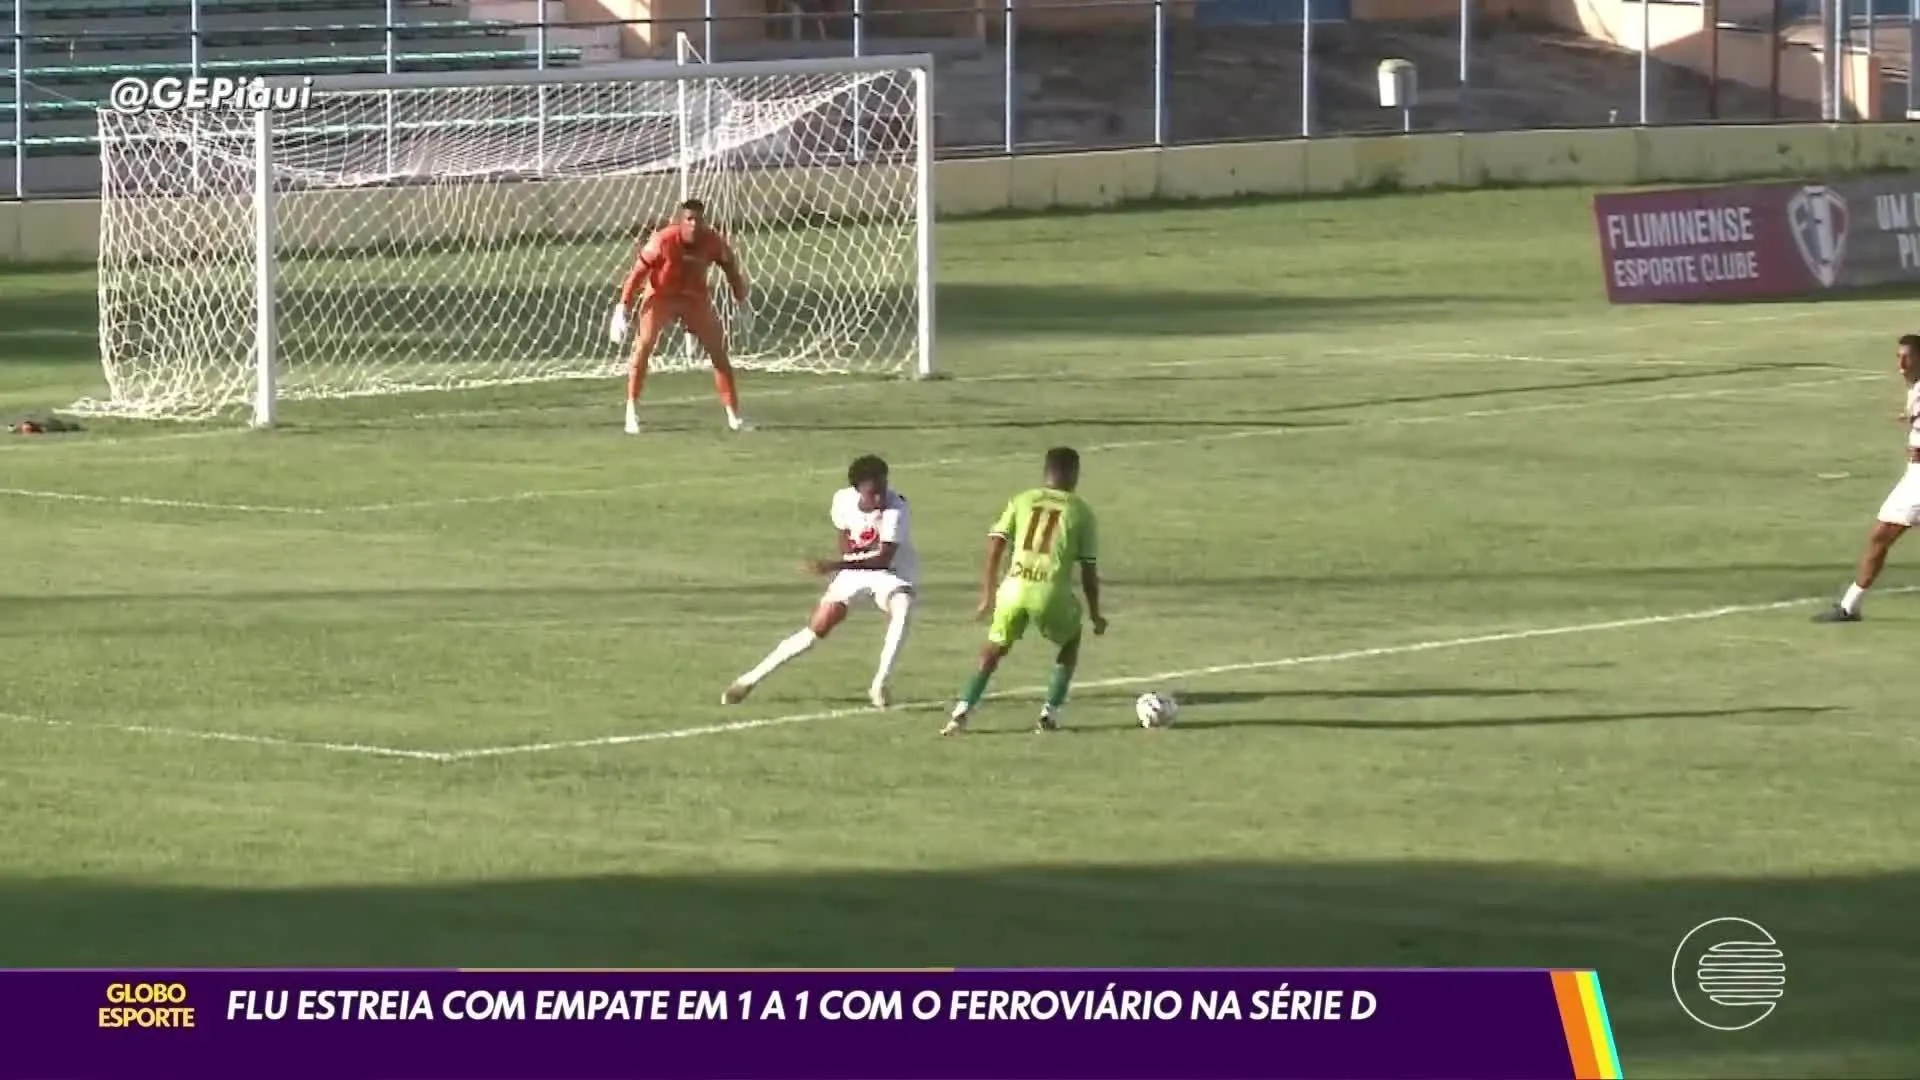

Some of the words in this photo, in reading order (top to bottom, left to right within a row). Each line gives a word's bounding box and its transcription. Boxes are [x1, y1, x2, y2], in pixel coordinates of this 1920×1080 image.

[1606, 206, 1755, 250] FLUMINENSE
[1875, 192, 1909, 231] UM
[1613, 255, 1698, 288] ESPORTE
[1700, 251, 1760, 282] CLUBE
[1023, 506, 1063, 554] 11
